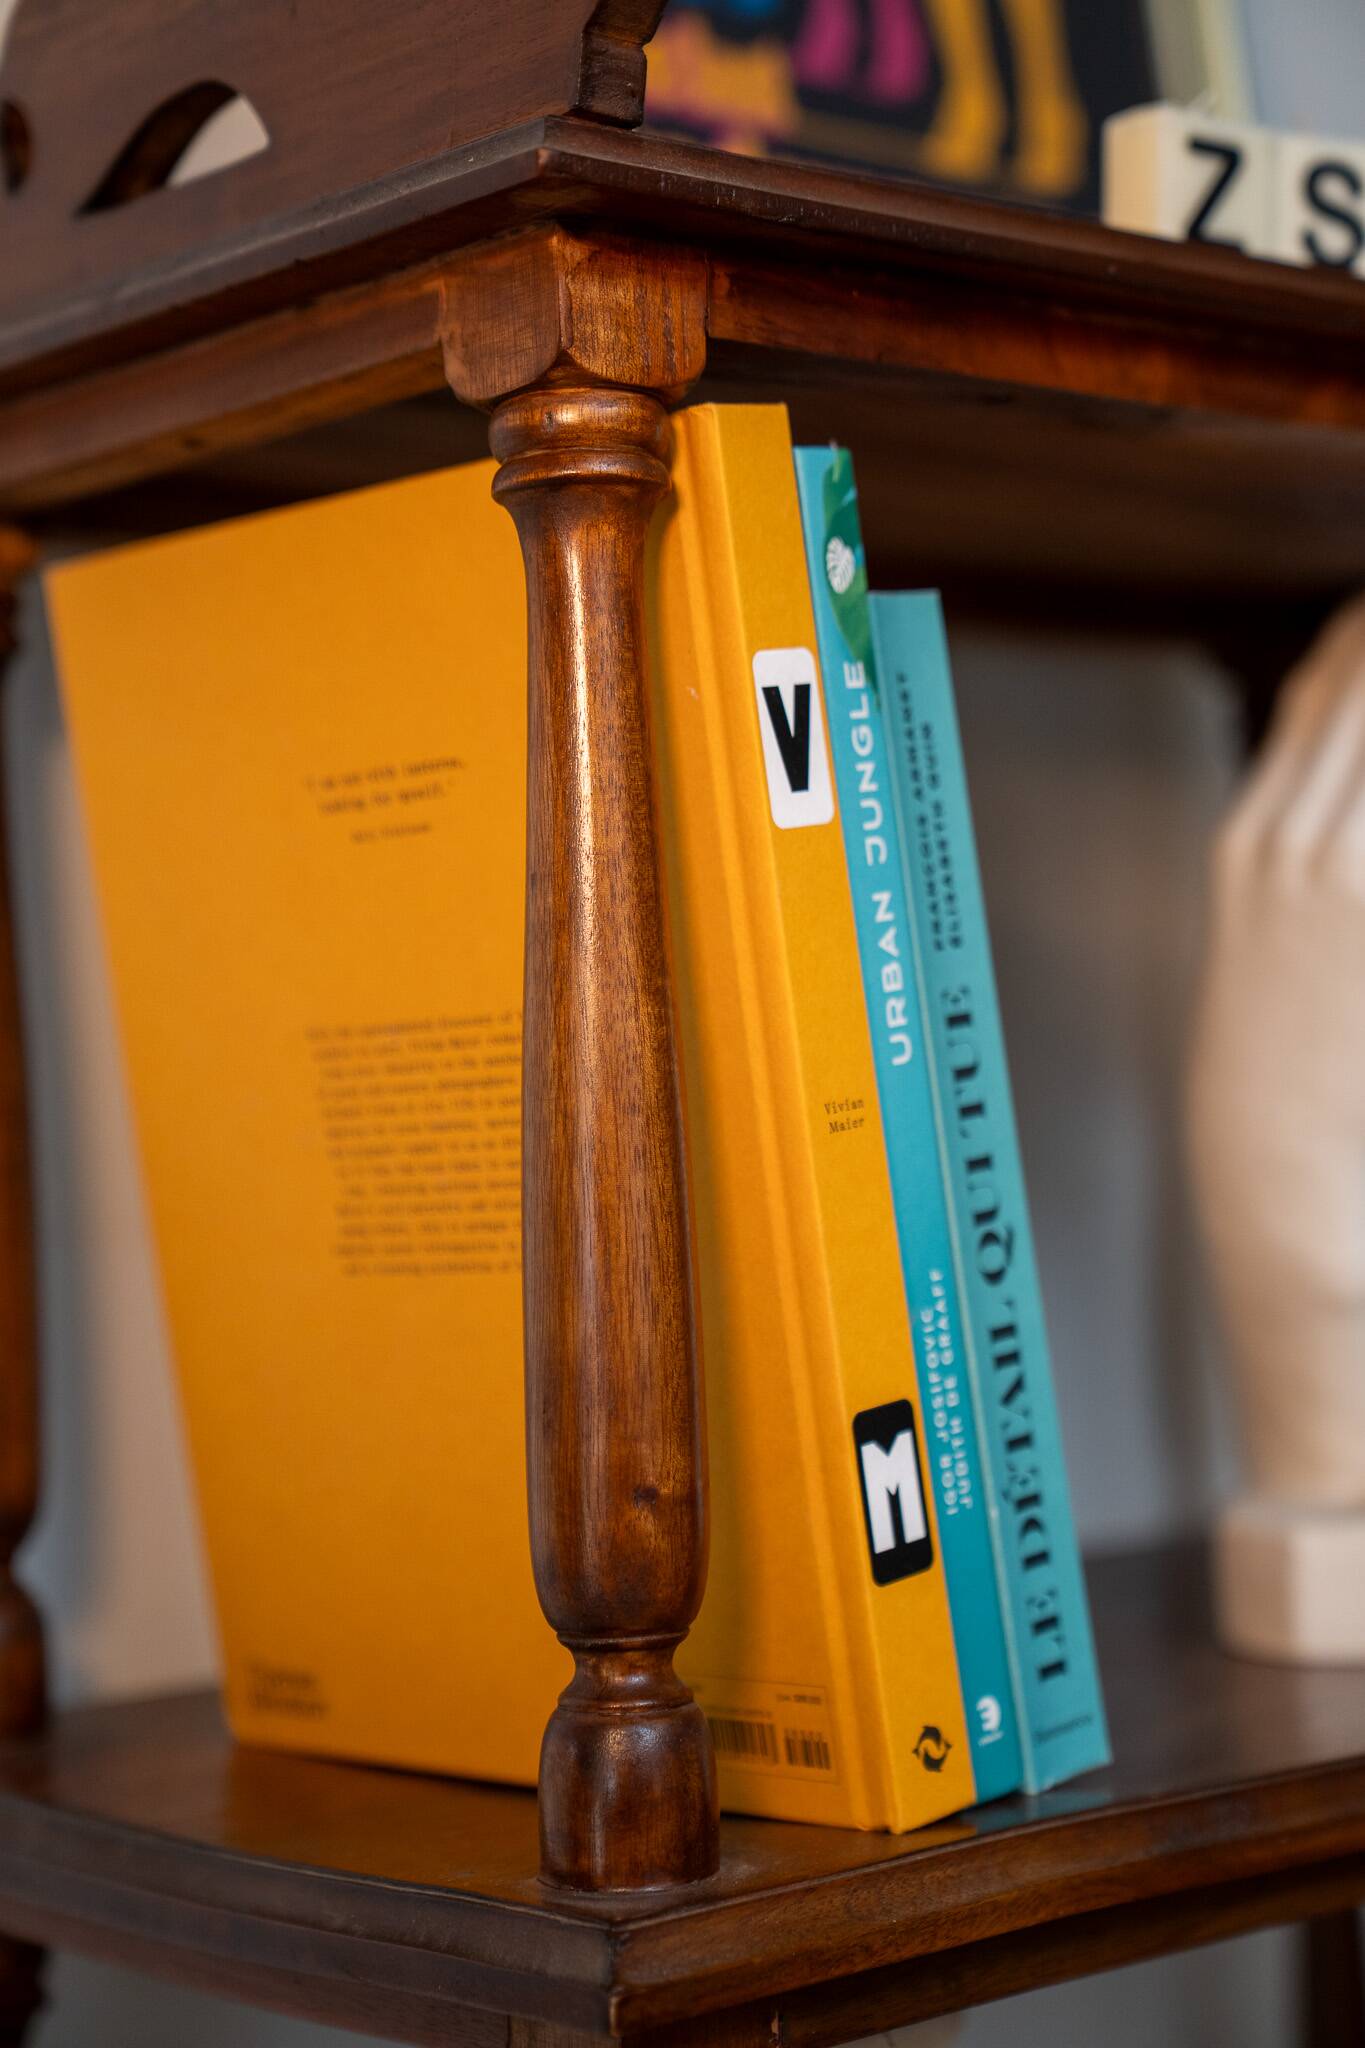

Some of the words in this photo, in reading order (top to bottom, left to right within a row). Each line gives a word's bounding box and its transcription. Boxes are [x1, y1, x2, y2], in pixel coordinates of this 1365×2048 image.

[762, 683, 810, 793] V
[843, 660, 888, 866] JUNGLE
[872, 891, 913, 1066] URBAN
[824, 1097, 864, 1114] Vivian
[940, 984, 986, 1139] TUE
[828, 1118, 864, 1134] Maier
[966, 1155, 1014, 1285] QUI
[929, 1268, 954, 1366] GRAAFF
[920, 1307, 949, 1442] JOSIFOVIC
[943, 1375, 960, 1407] DE
[940, 1454, 958, 1515] IGOR
[950, 1415, 973, 1508] JUDITH
[990, 1298, 1051, 1571] DÉTAIL
[861, 1429, 927, 1554] M
[1026, 1586, 1067, 1682] LE
